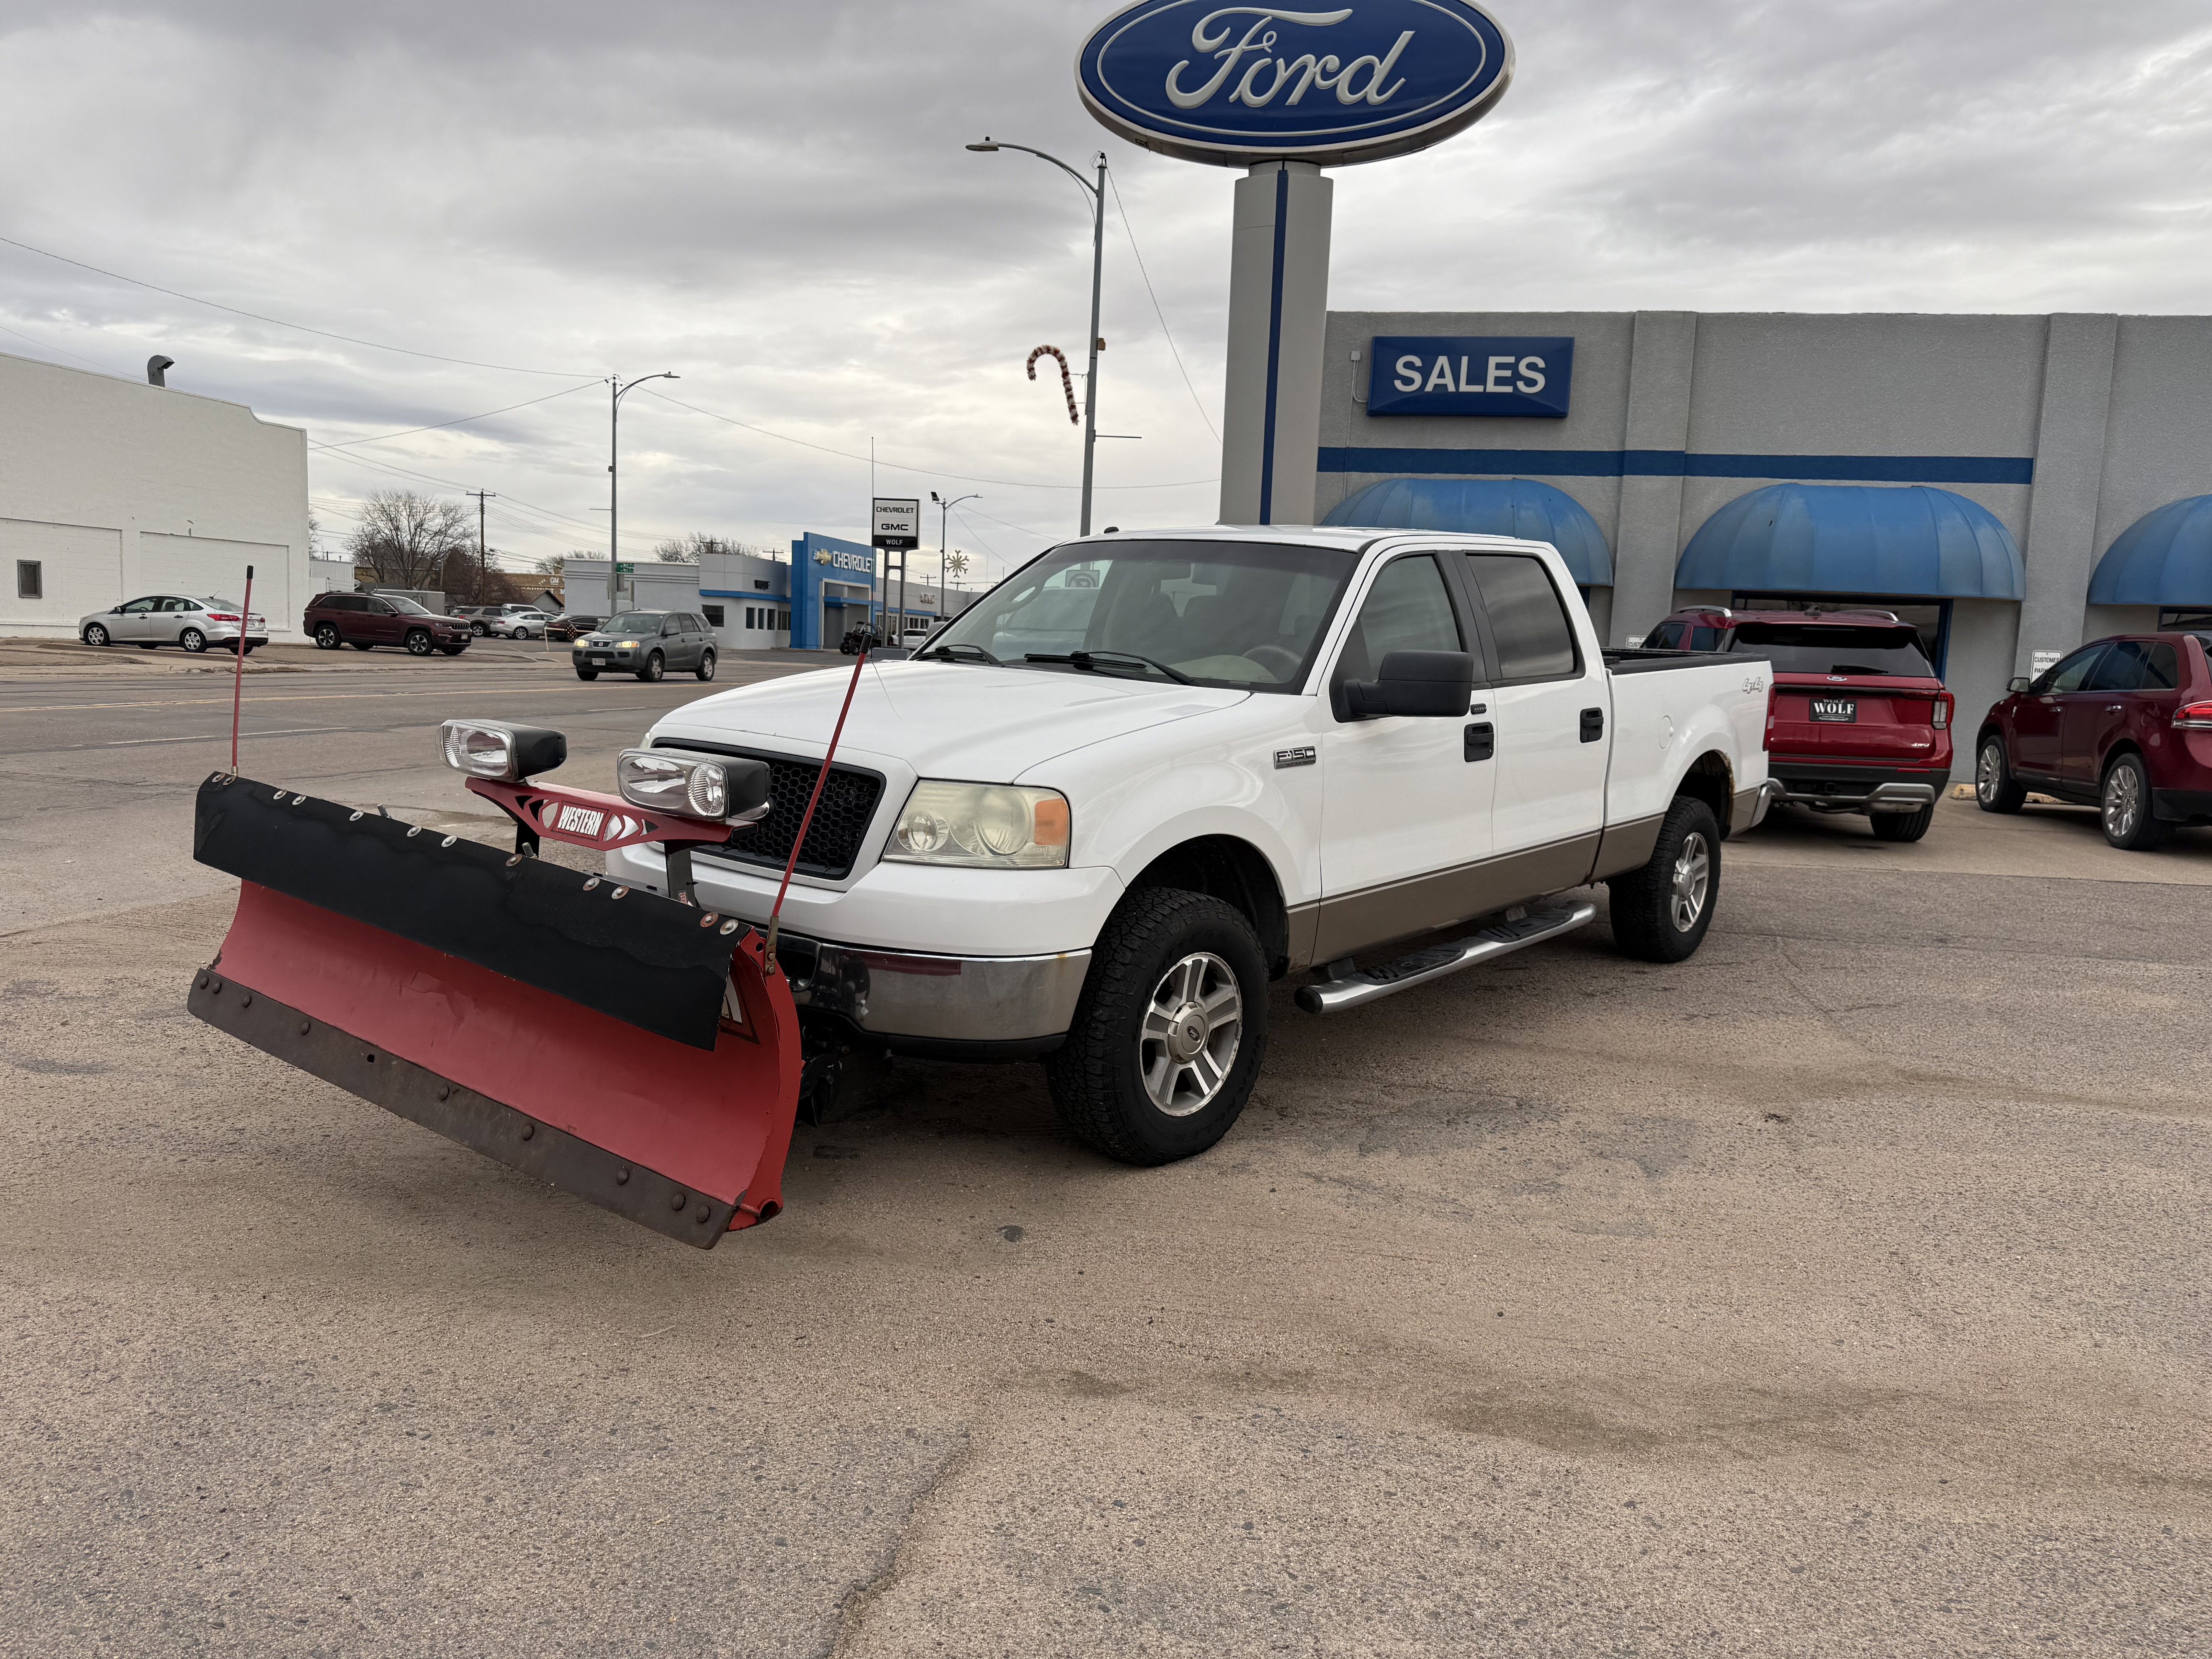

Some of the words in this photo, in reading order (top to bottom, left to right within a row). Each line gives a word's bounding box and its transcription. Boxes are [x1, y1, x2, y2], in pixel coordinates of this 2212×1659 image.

[1166, 8, 1416, 108] Ford
[1394, 355, 1546, 394] SALES
[833, 551, 874, 573] CHEVROLET
[1814, 702, 1854, 714] WOLF
[557, 805, 604, 836] WESTERN
